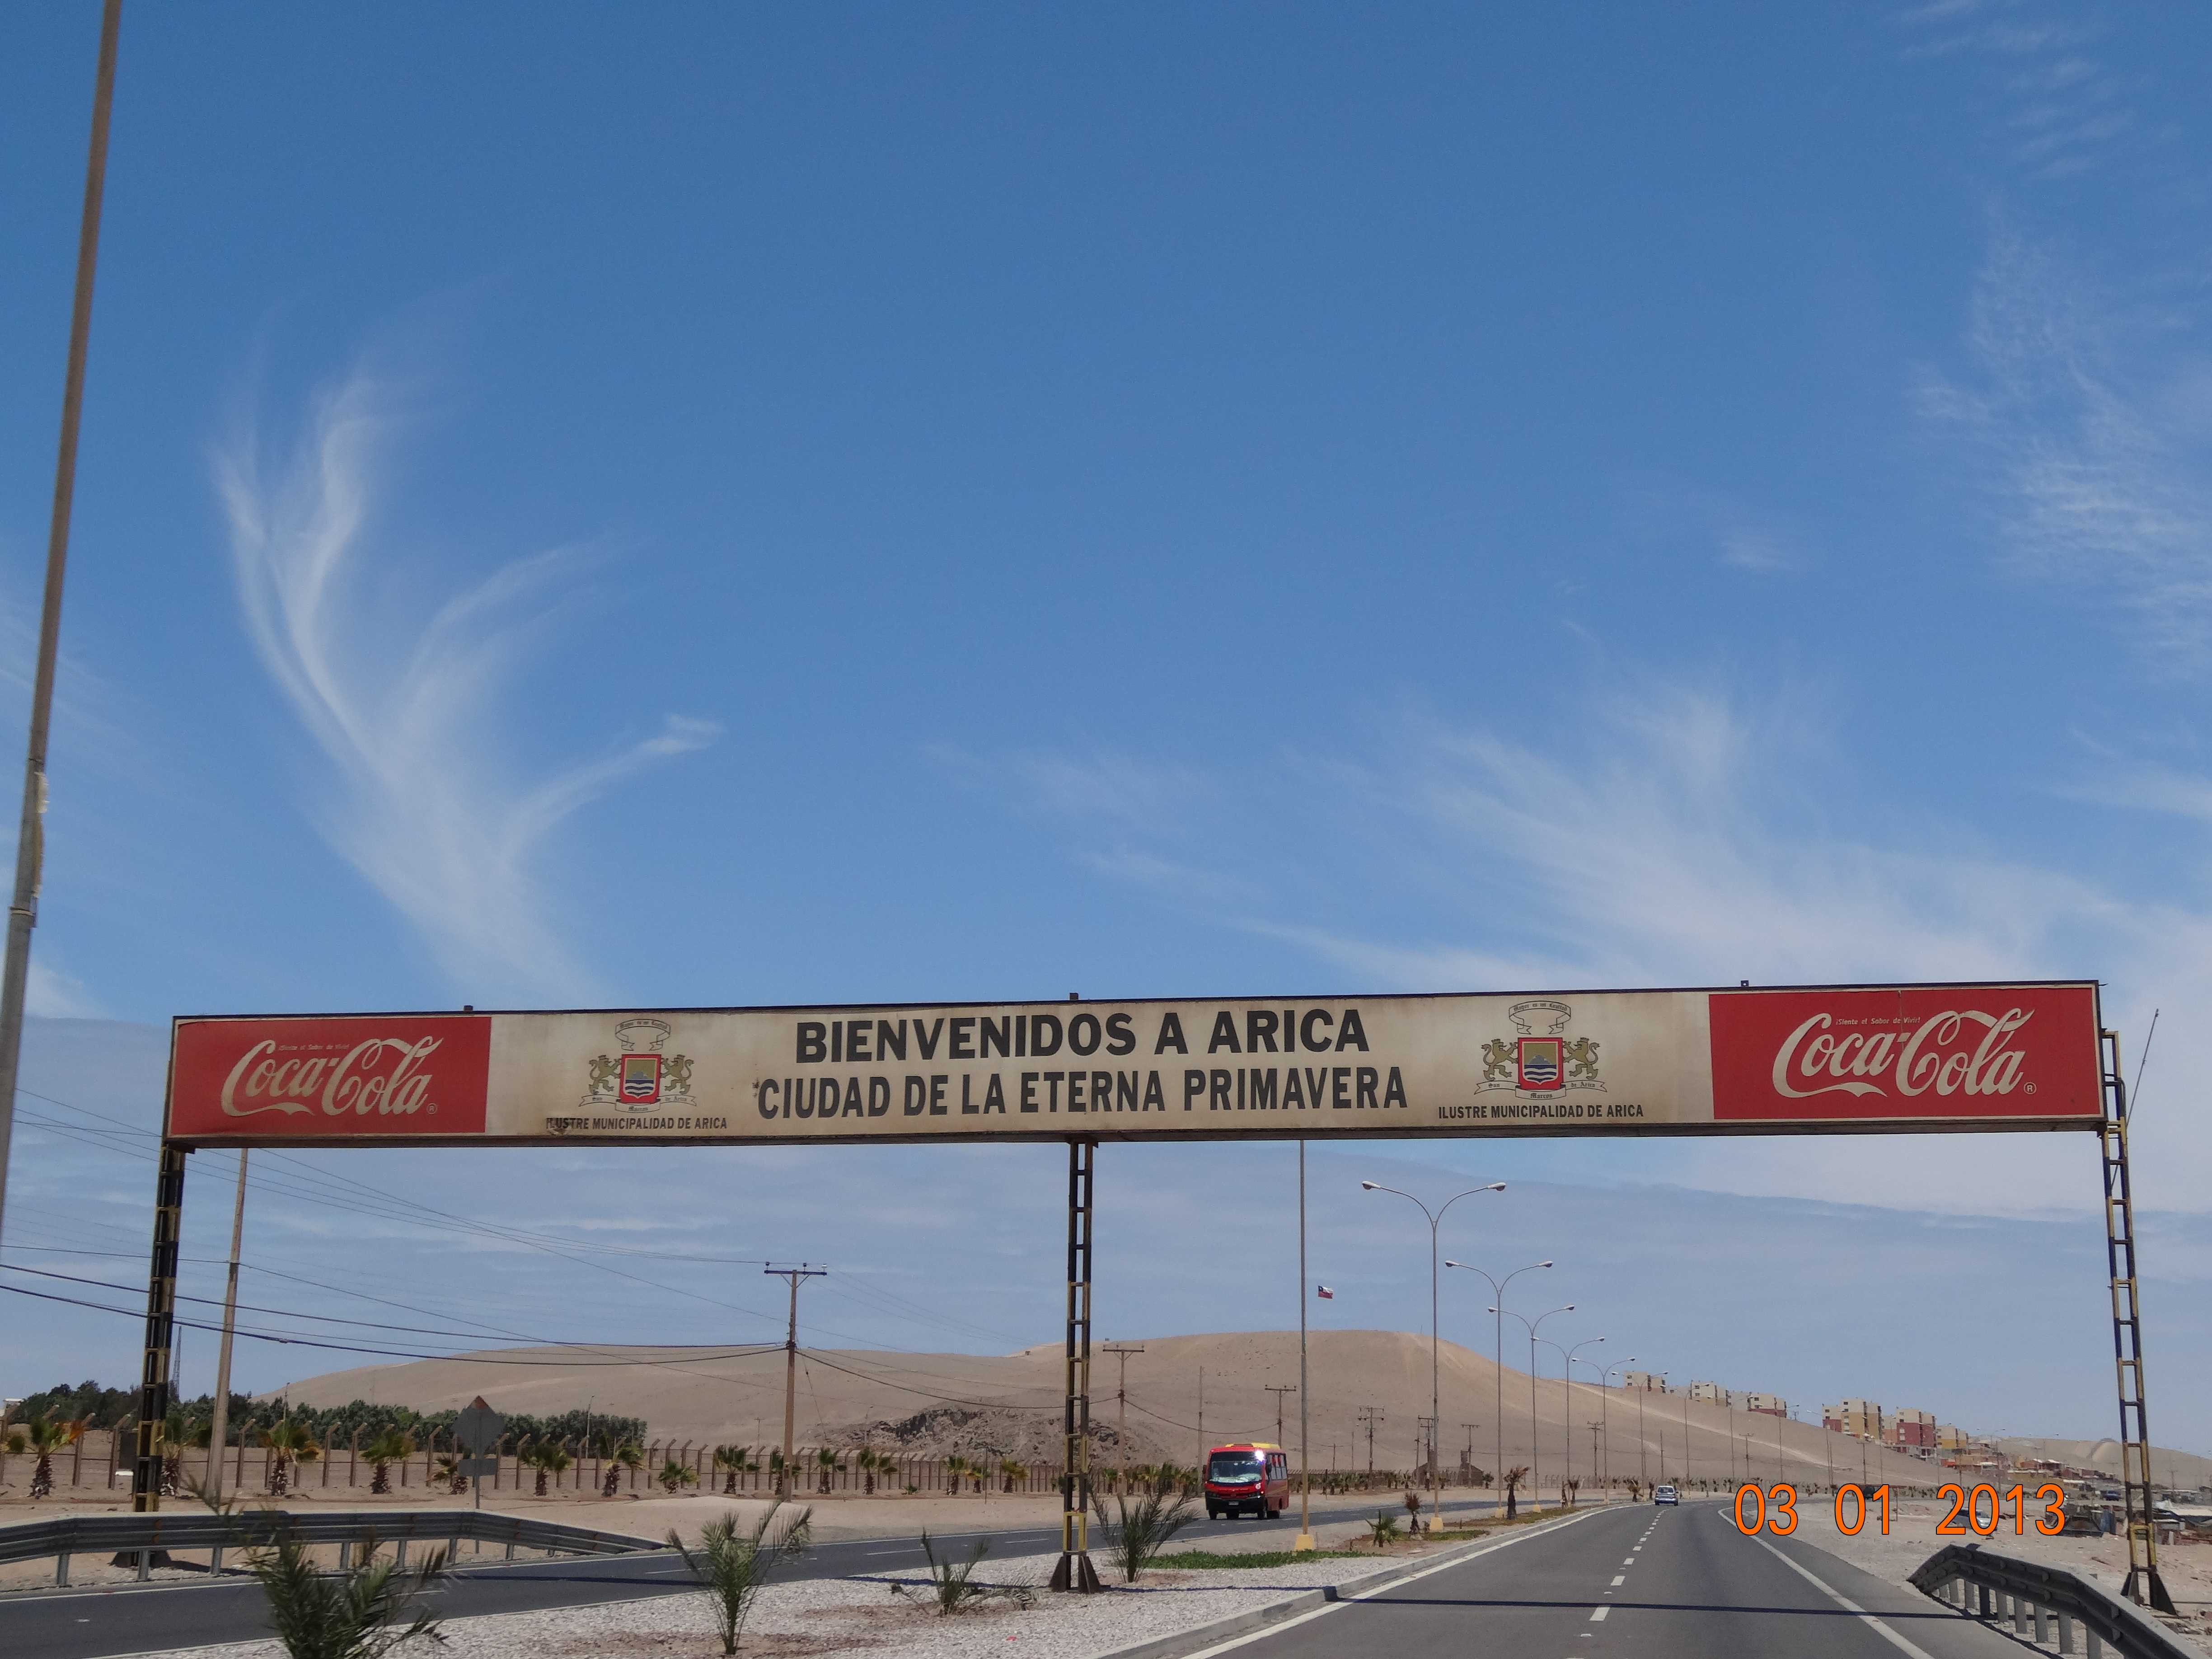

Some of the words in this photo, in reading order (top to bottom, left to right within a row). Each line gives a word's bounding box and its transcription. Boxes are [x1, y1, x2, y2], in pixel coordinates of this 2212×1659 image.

[796, 1012, 1136, 1064] BIENVENIDOS
[1154, 1012, 1189, 1055] A
[1207, 1008, 1370, 1054] ARICA
[758, 1076, 891, 1120] CIUDAD
[904, 1074, 948, 1116] DE
[961, 1073, 1006, 1115] LA
[1020, 1070, 1166, 1113] ETERNA
[1184, 1066, 1408, 1111] PRIMAVERA
[546, 1117, 589, 1129] ILUSTRE
[592, 1118, 674, 1129] MUNICIPALIDAD
[678, 1118, 691, 1129] DE
[694, 1117, 727, 1129] ARICA
[1439, 1106, 1487, 1119] ILUSTRE
[1491, 1105, 1584, 1118] MUNICIPALIDAD
[1587, 1105, 1603, 1117] DE
[1607, 1105, 1644, 1117] ARICA
